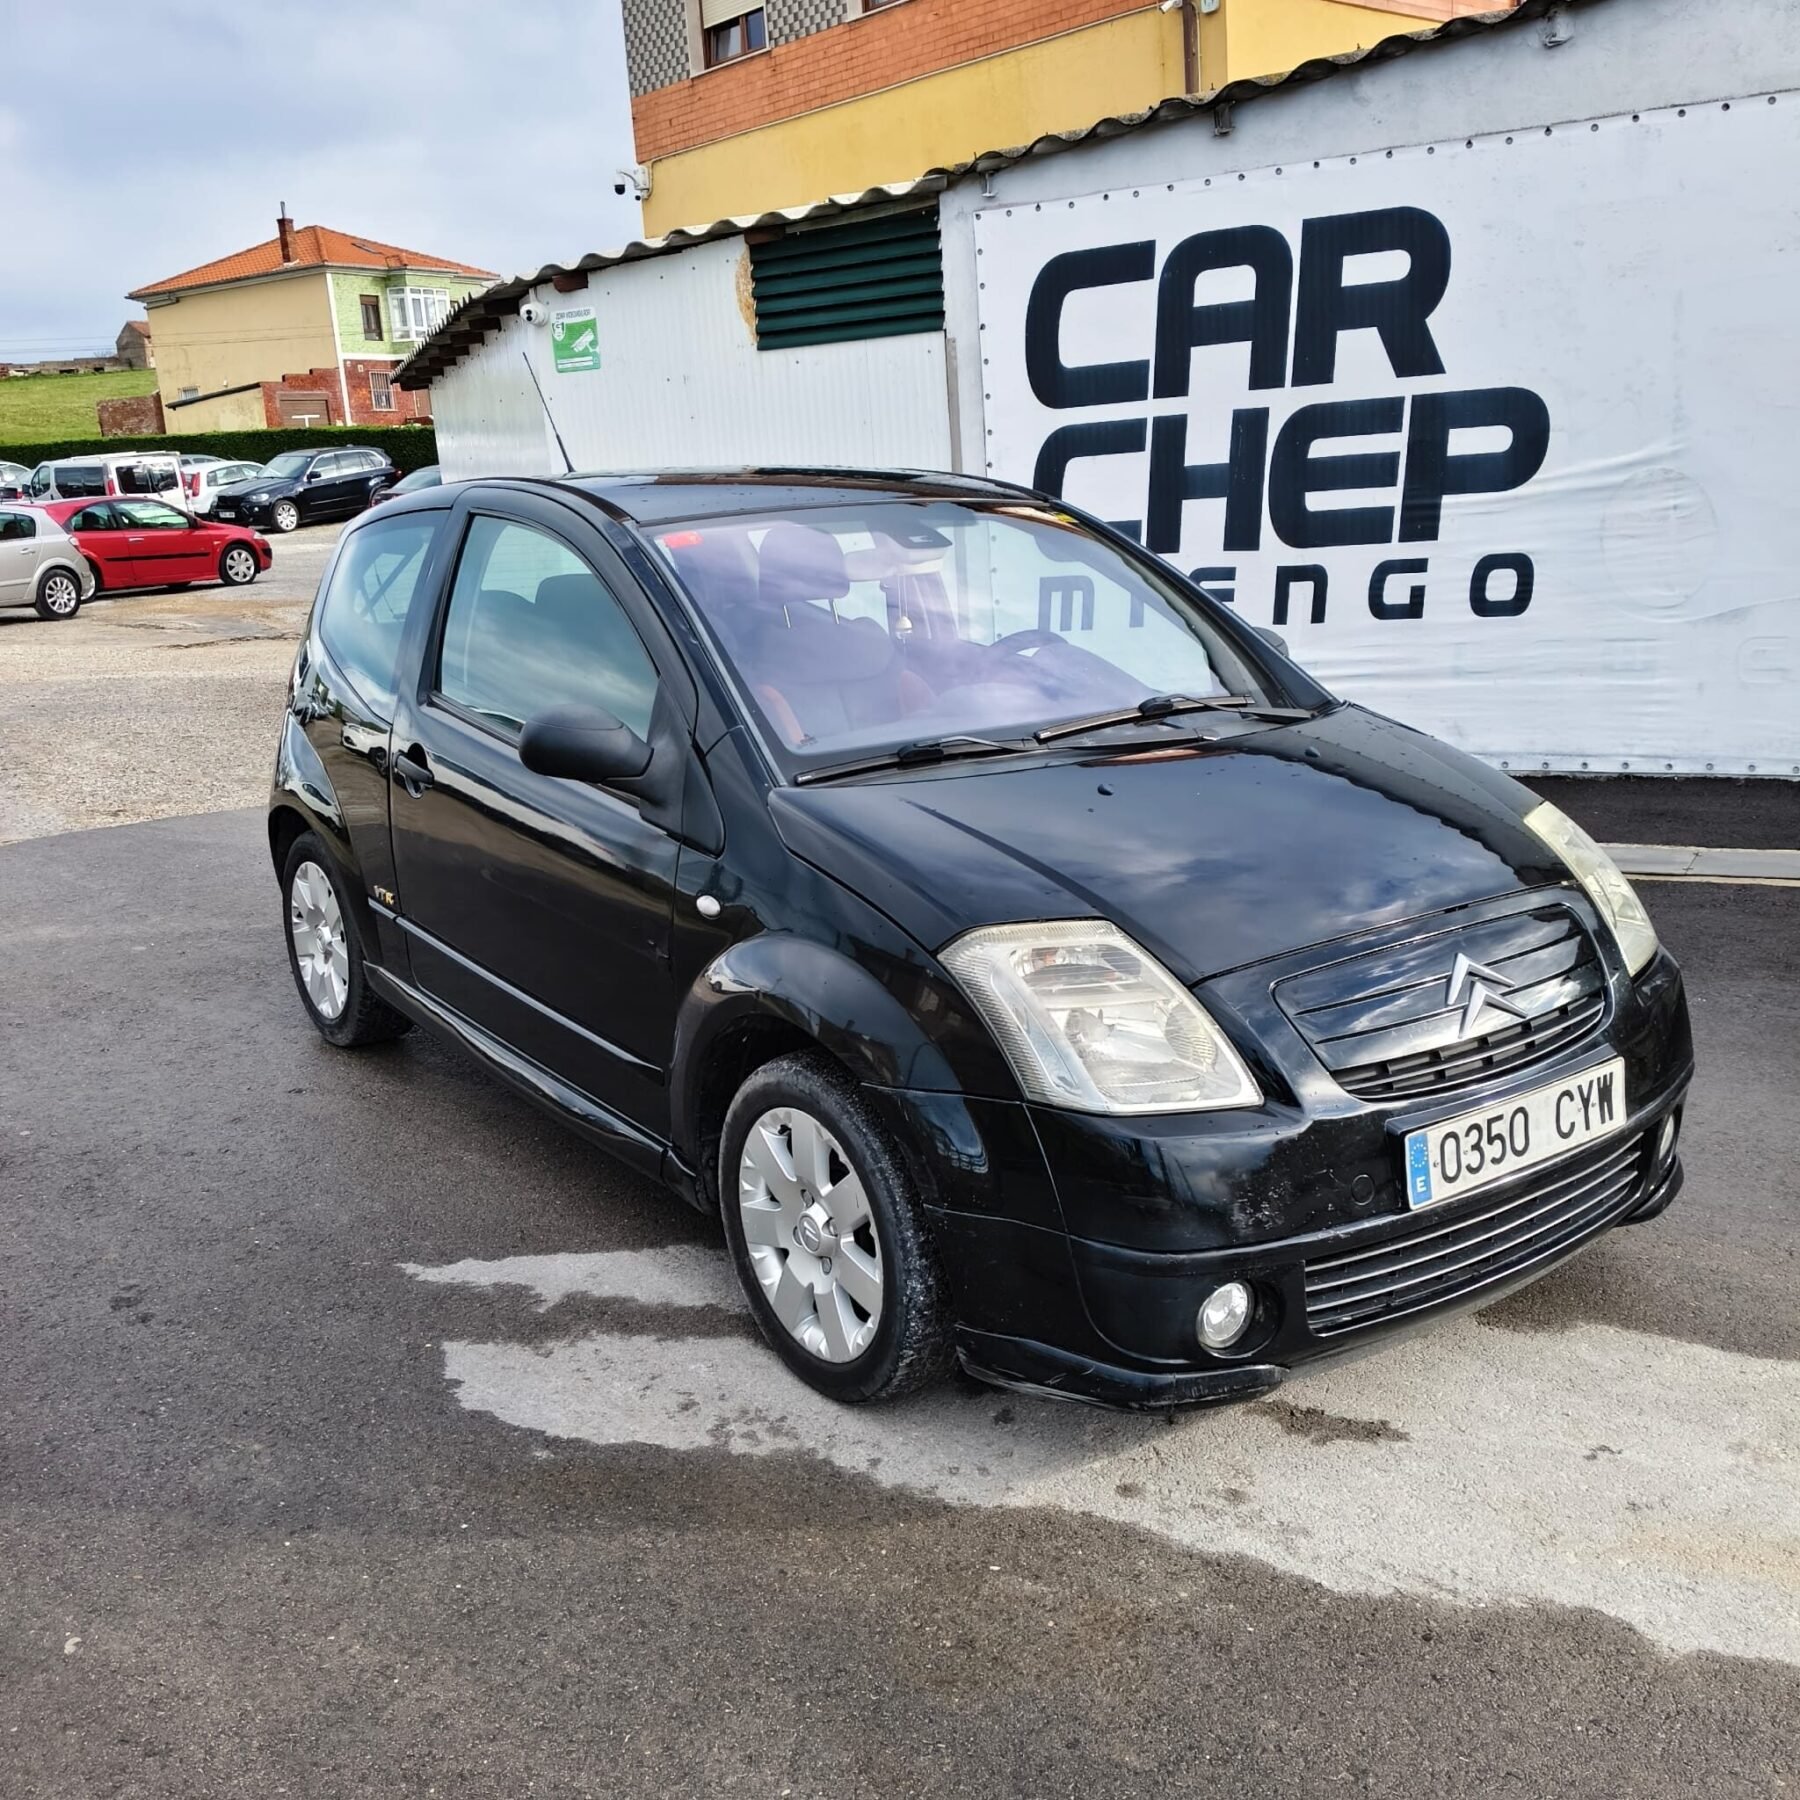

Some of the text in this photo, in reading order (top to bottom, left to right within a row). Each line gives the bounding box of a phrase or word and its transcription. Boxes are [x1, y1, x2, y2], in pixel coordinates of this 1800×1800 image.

[1025, 206, 1451, 409] CAR
[1032, 387, 1550, 561] CHEP
[1416, 1071, 1614, 1193] E 0350 CYW
